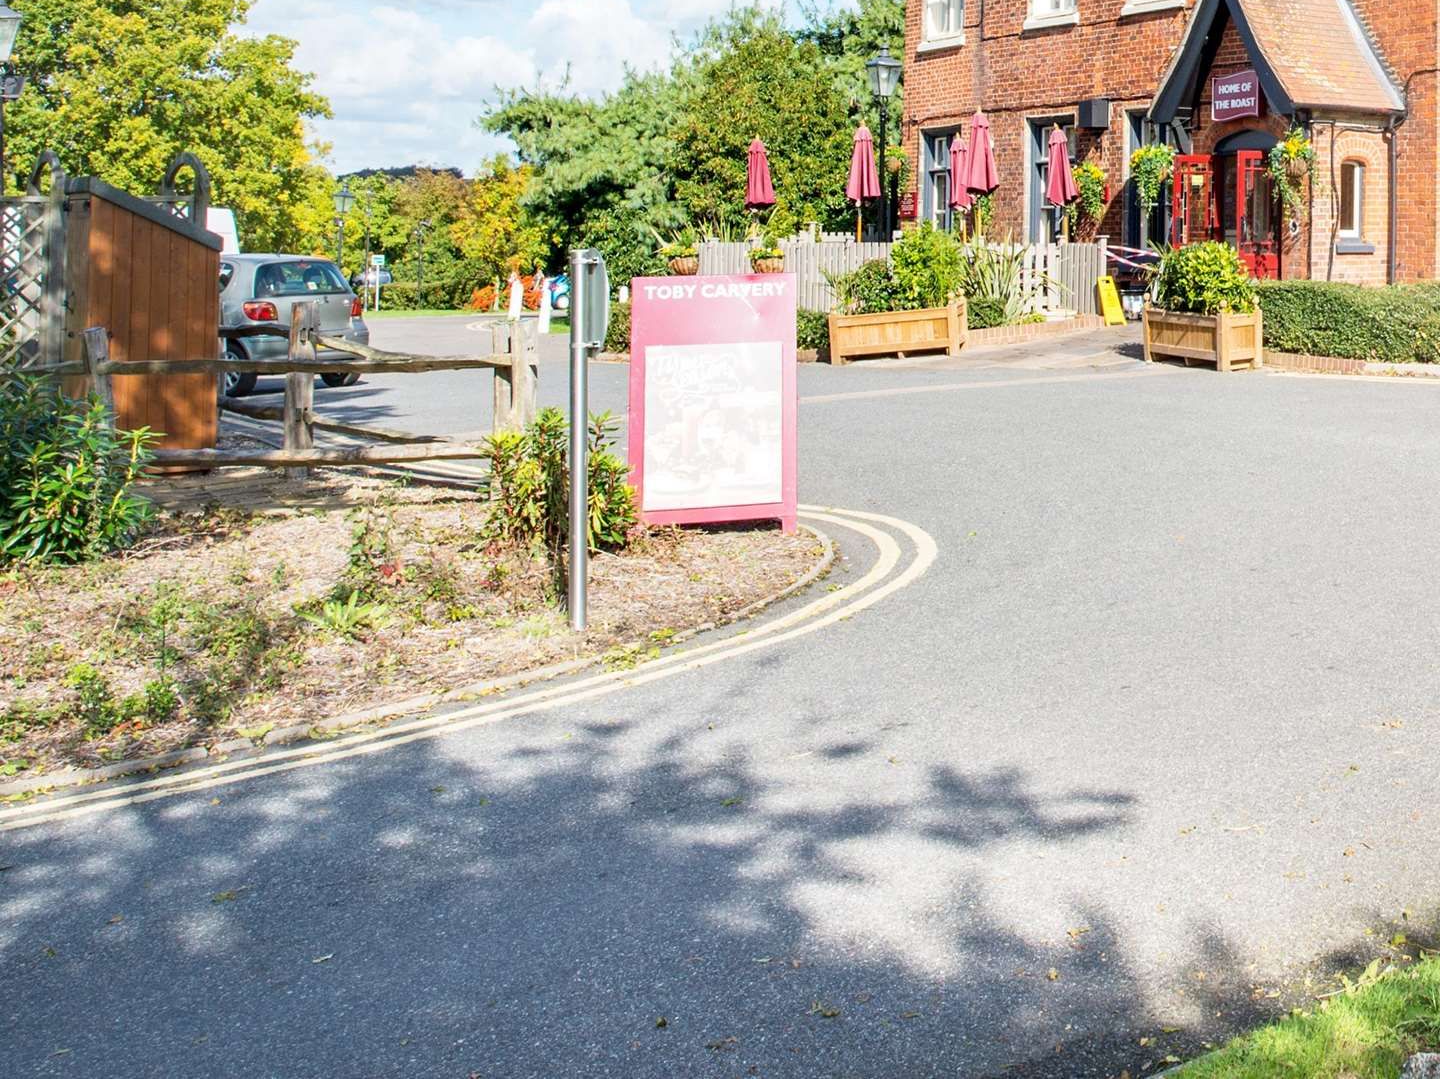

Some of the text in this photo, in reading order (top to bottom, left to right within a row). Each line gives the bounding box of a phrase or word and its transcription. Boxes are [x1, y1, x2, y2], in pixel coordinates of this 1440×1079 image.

[1218, 82, 1252, 95] HOME OF
[1214, 97, 1256, 110] THE ROAST
[643, 281, 788, 300] TOBY CARVERY
